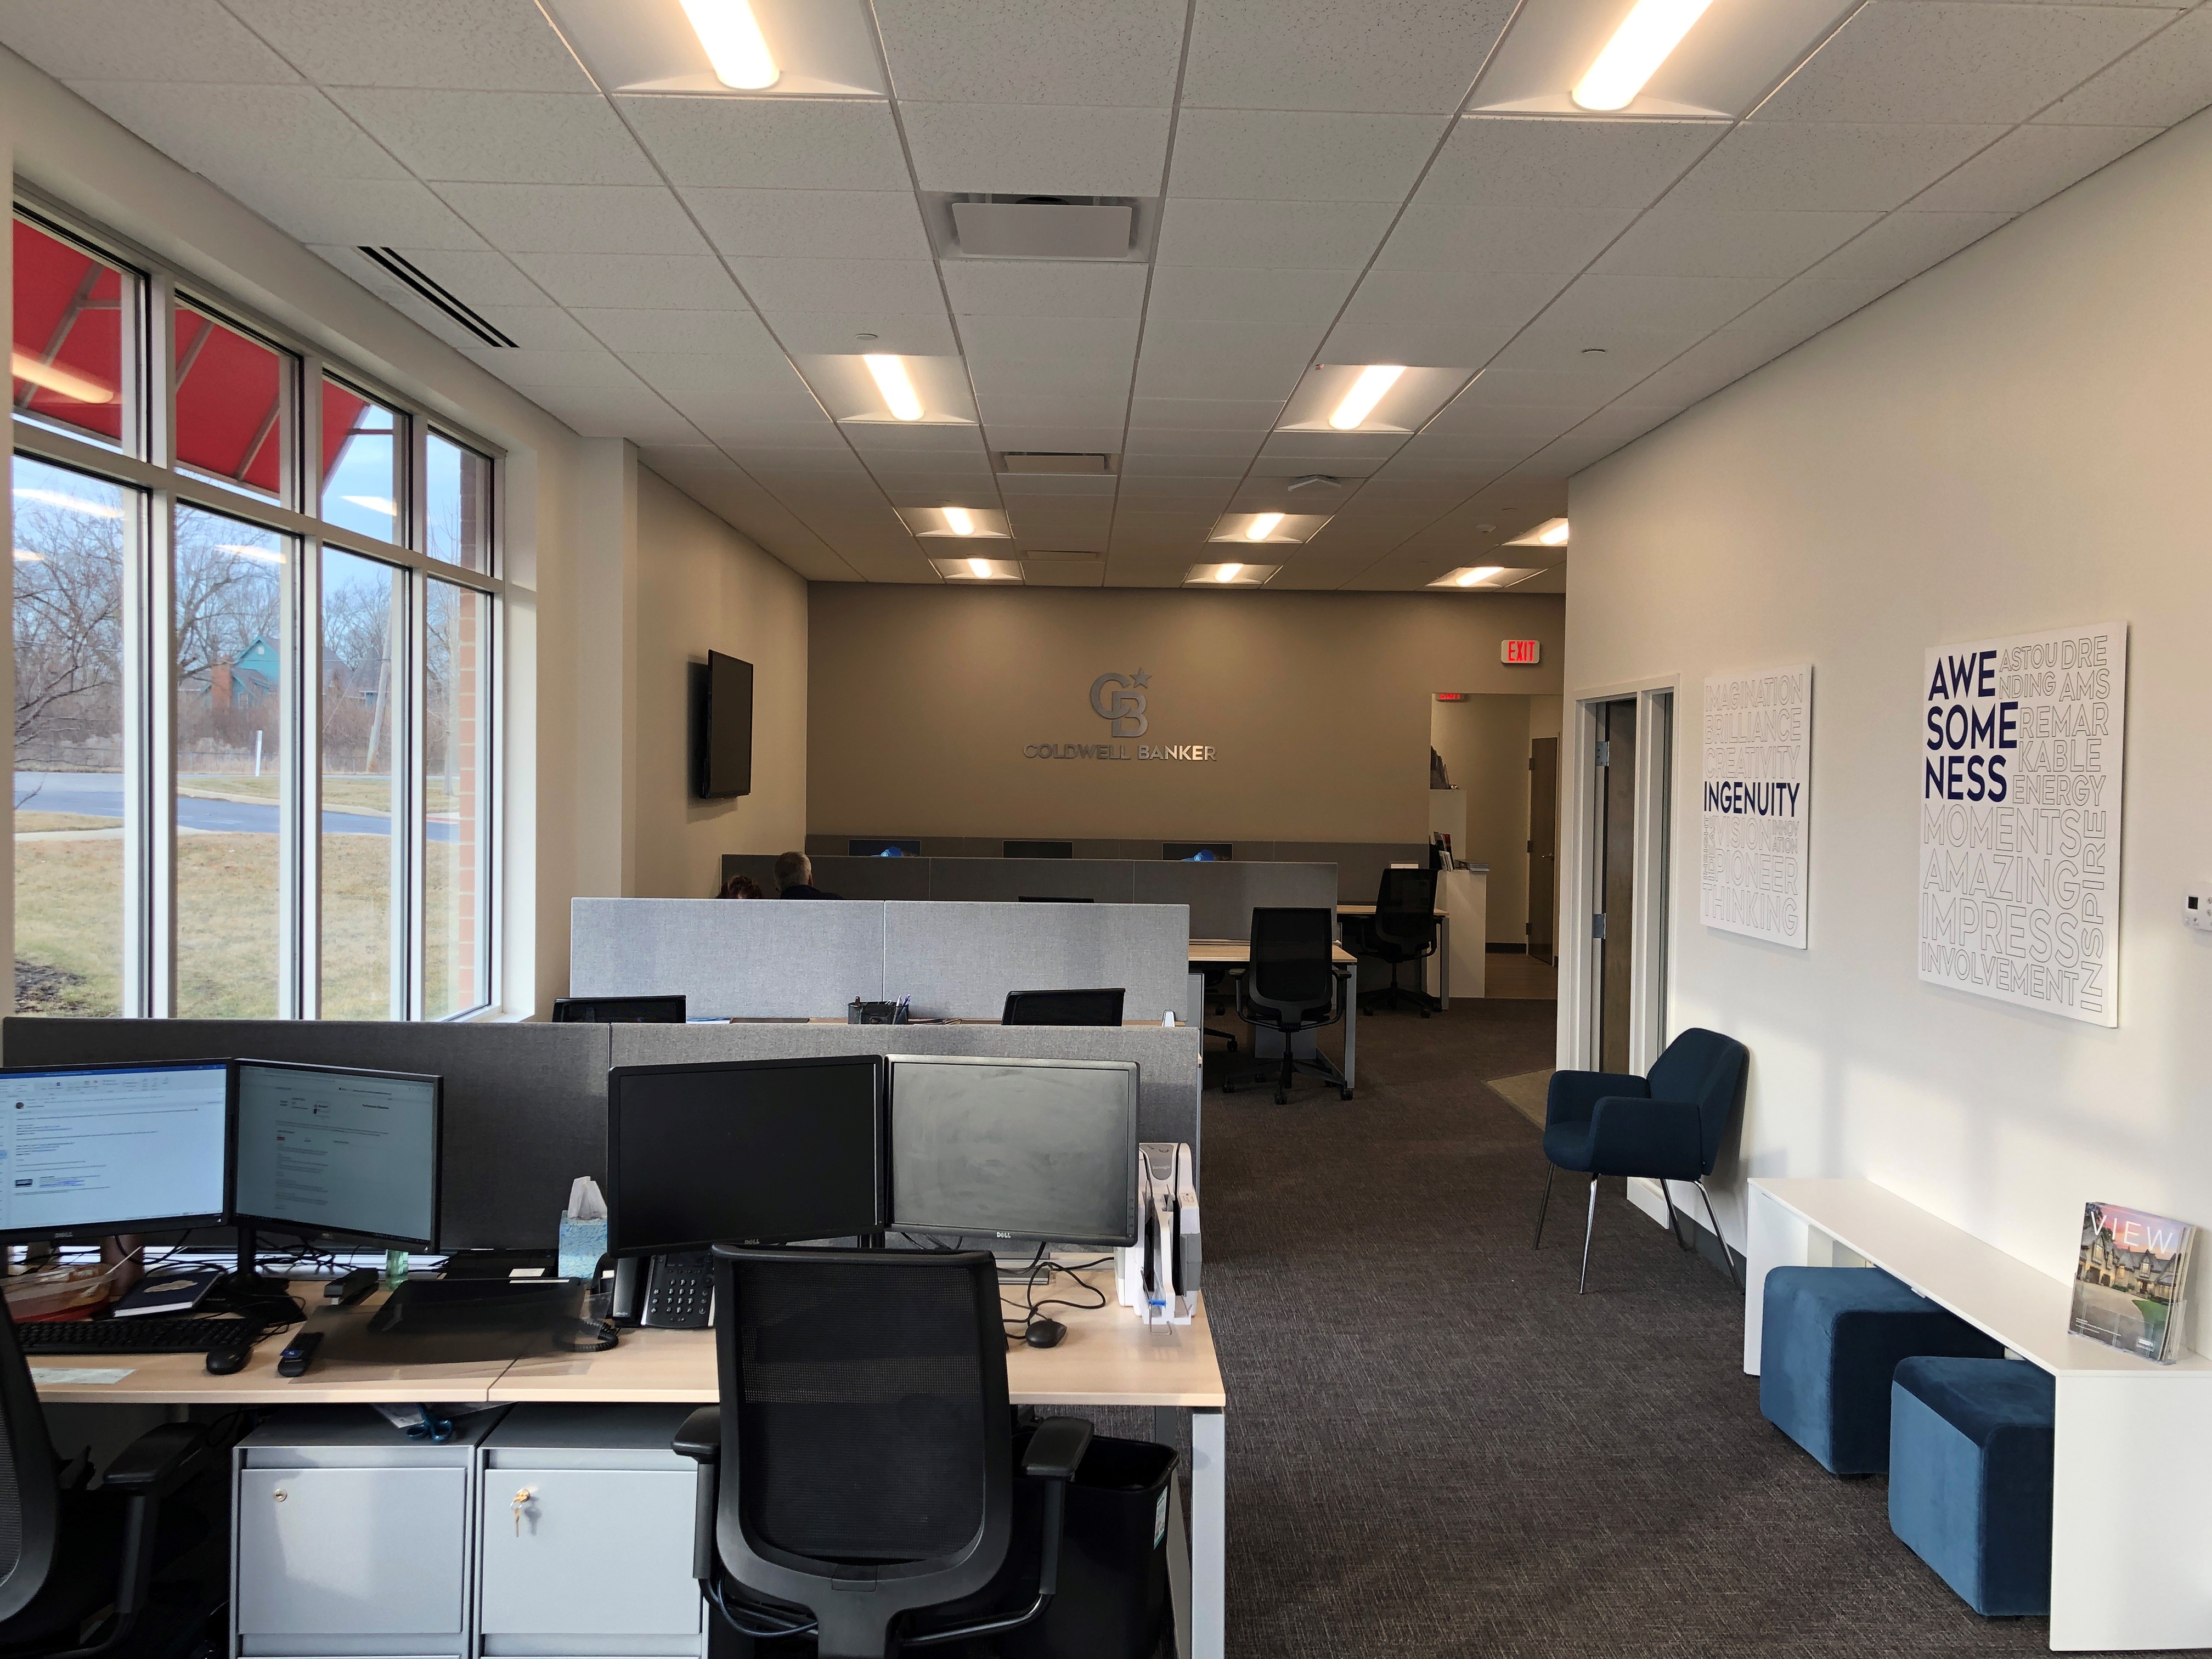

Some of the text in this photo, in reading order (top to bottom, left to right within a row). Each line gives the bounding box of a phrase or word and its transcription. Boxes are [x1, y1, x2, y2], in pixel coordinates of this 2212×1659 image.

[1508, 641, 1535, 662] EXIT
[1999, 642, 2058, 672] ASTOU
[2061, 635, 2108, 670] DRE
[1705, 674, 1803, 712] IMAGINATION
[1928, 650, 1997, 701] AWE
[1999, 671, 2056, 699] NDING
[2059, 669, 2111, 702] AMS
[1705, 708, 1802, 744] BRILLIANCE
[1927, 701, 2018, 751] SOME
[2019, 702, 2109, 738] REMAR
[1023, 743, 1217, 761] COLDWELL BANKER
[1703, 745, 1801, 779] CREATIVITY
[2018, 738, 2102, 772] KABLE
[1925, 755, 2007, 802] NESS
[2012, 775, 2106, 806] ENERGY
[1703, 781, 1801, 817] INGENUITY
[1712, 815, 1771, 851] VISION
[1771, 837, 1798, 854] ATION
[1772, 819, 1800, 837] INNOV
[1924, 803, 2081, 858] MOMENTS
[1715, 848, 1798, 896] PIONEER
[1923, 848, 2080, 910] AMAZING
[1702, 882, 1798, 937] THINKING
[2081, 810, 2106, 1013] INSPIRE
[1922, 892, 2080, 968] IMPRESS
[1921, 941, 2079, 1006] INVOLVEMENT
[2090, 1210, 2174, 1255] VIEW
